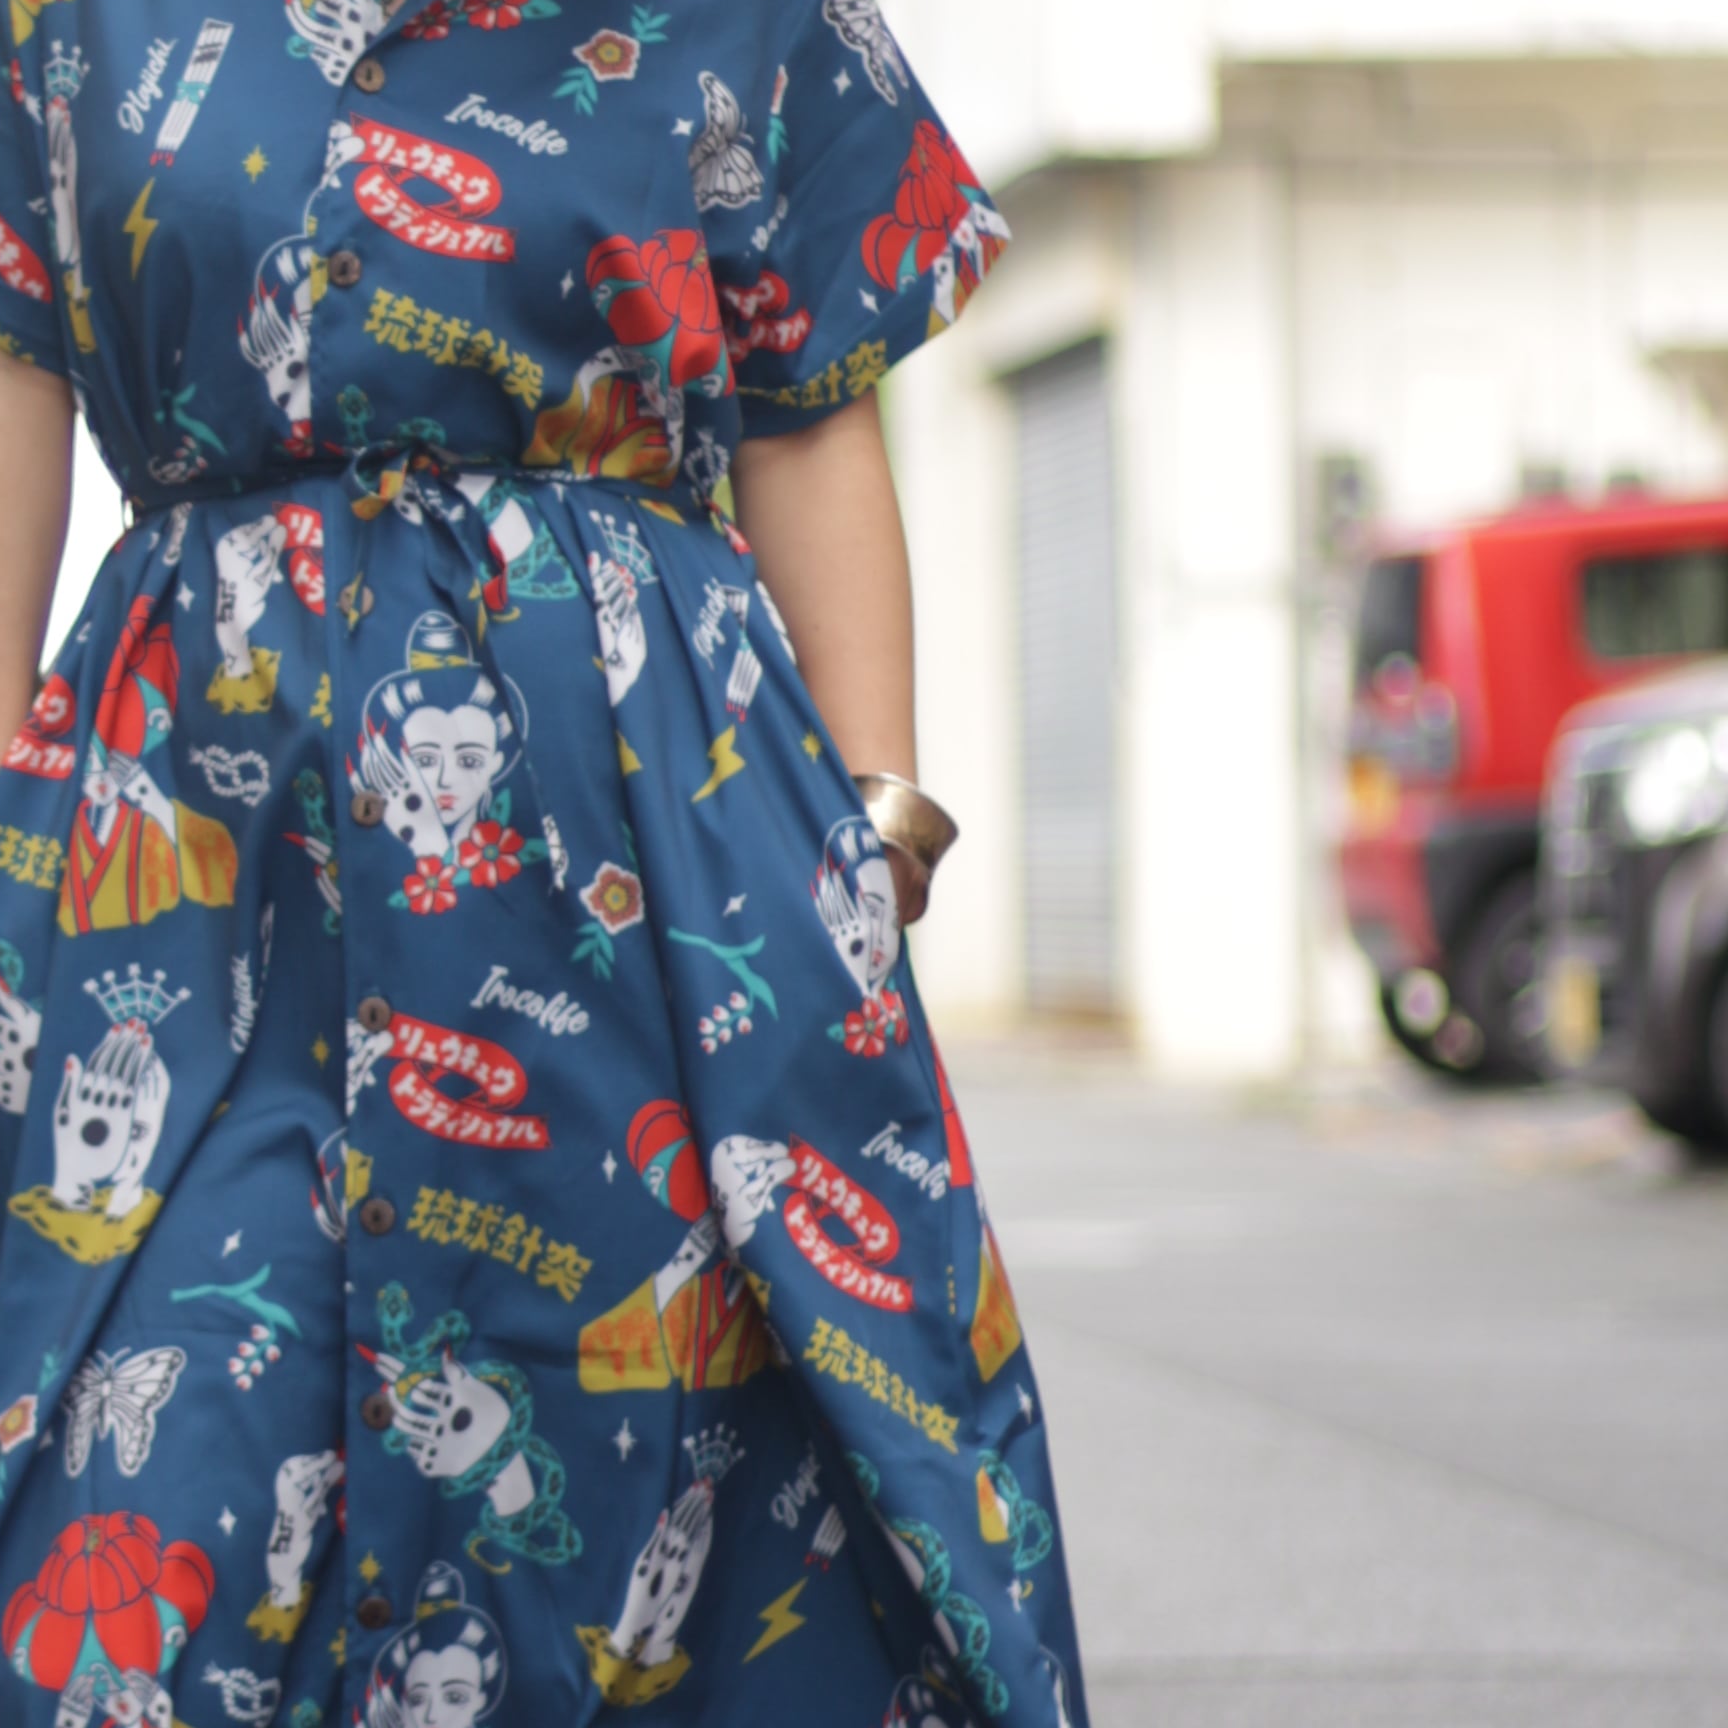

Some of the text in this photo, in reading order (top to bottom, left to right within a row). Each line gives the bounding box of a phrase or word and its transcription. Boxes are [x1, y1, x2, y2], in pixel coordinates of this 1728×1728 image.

[370, 130, 491, 205] リュウキュウ
[358, 174, 507, 255] トラディショナル
[398, 1023, 517, 1096] リュウキュウ
[392, 1070, 541, 1143] トラディショナル
[800, 1154, 890, 1252] リュウキュウ
